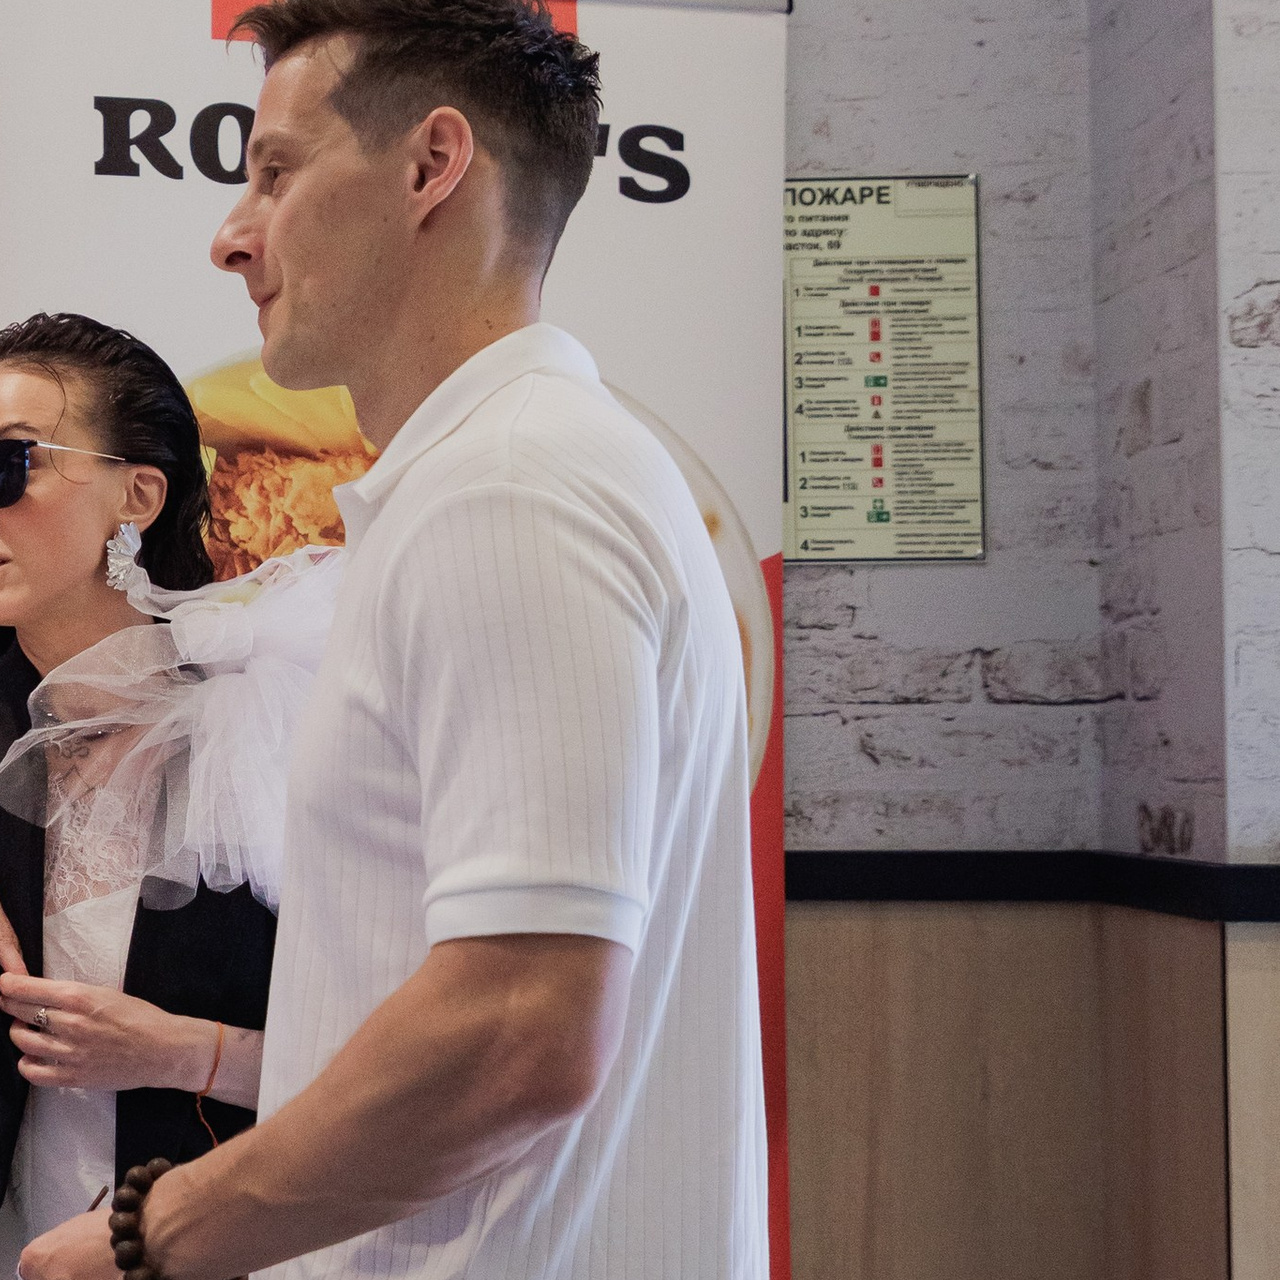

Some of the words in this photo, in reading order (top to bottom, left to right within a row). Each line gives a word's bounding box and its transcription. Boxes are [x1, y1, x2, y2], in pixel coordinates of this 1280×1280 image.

[785, 185, 891, 206] ПОЖАРЕ
[796, 326, 803, 338] 1
[794, 352, 804, 366] 2
[795, 377, 804, 389] 3
[794, 404, 804, 415] 4
[800, 452, 806, 464] 1
[799, 477, 808, 490] 2
[800, 506, 809, 518] 3
[800, 540, 810, 551] 4
